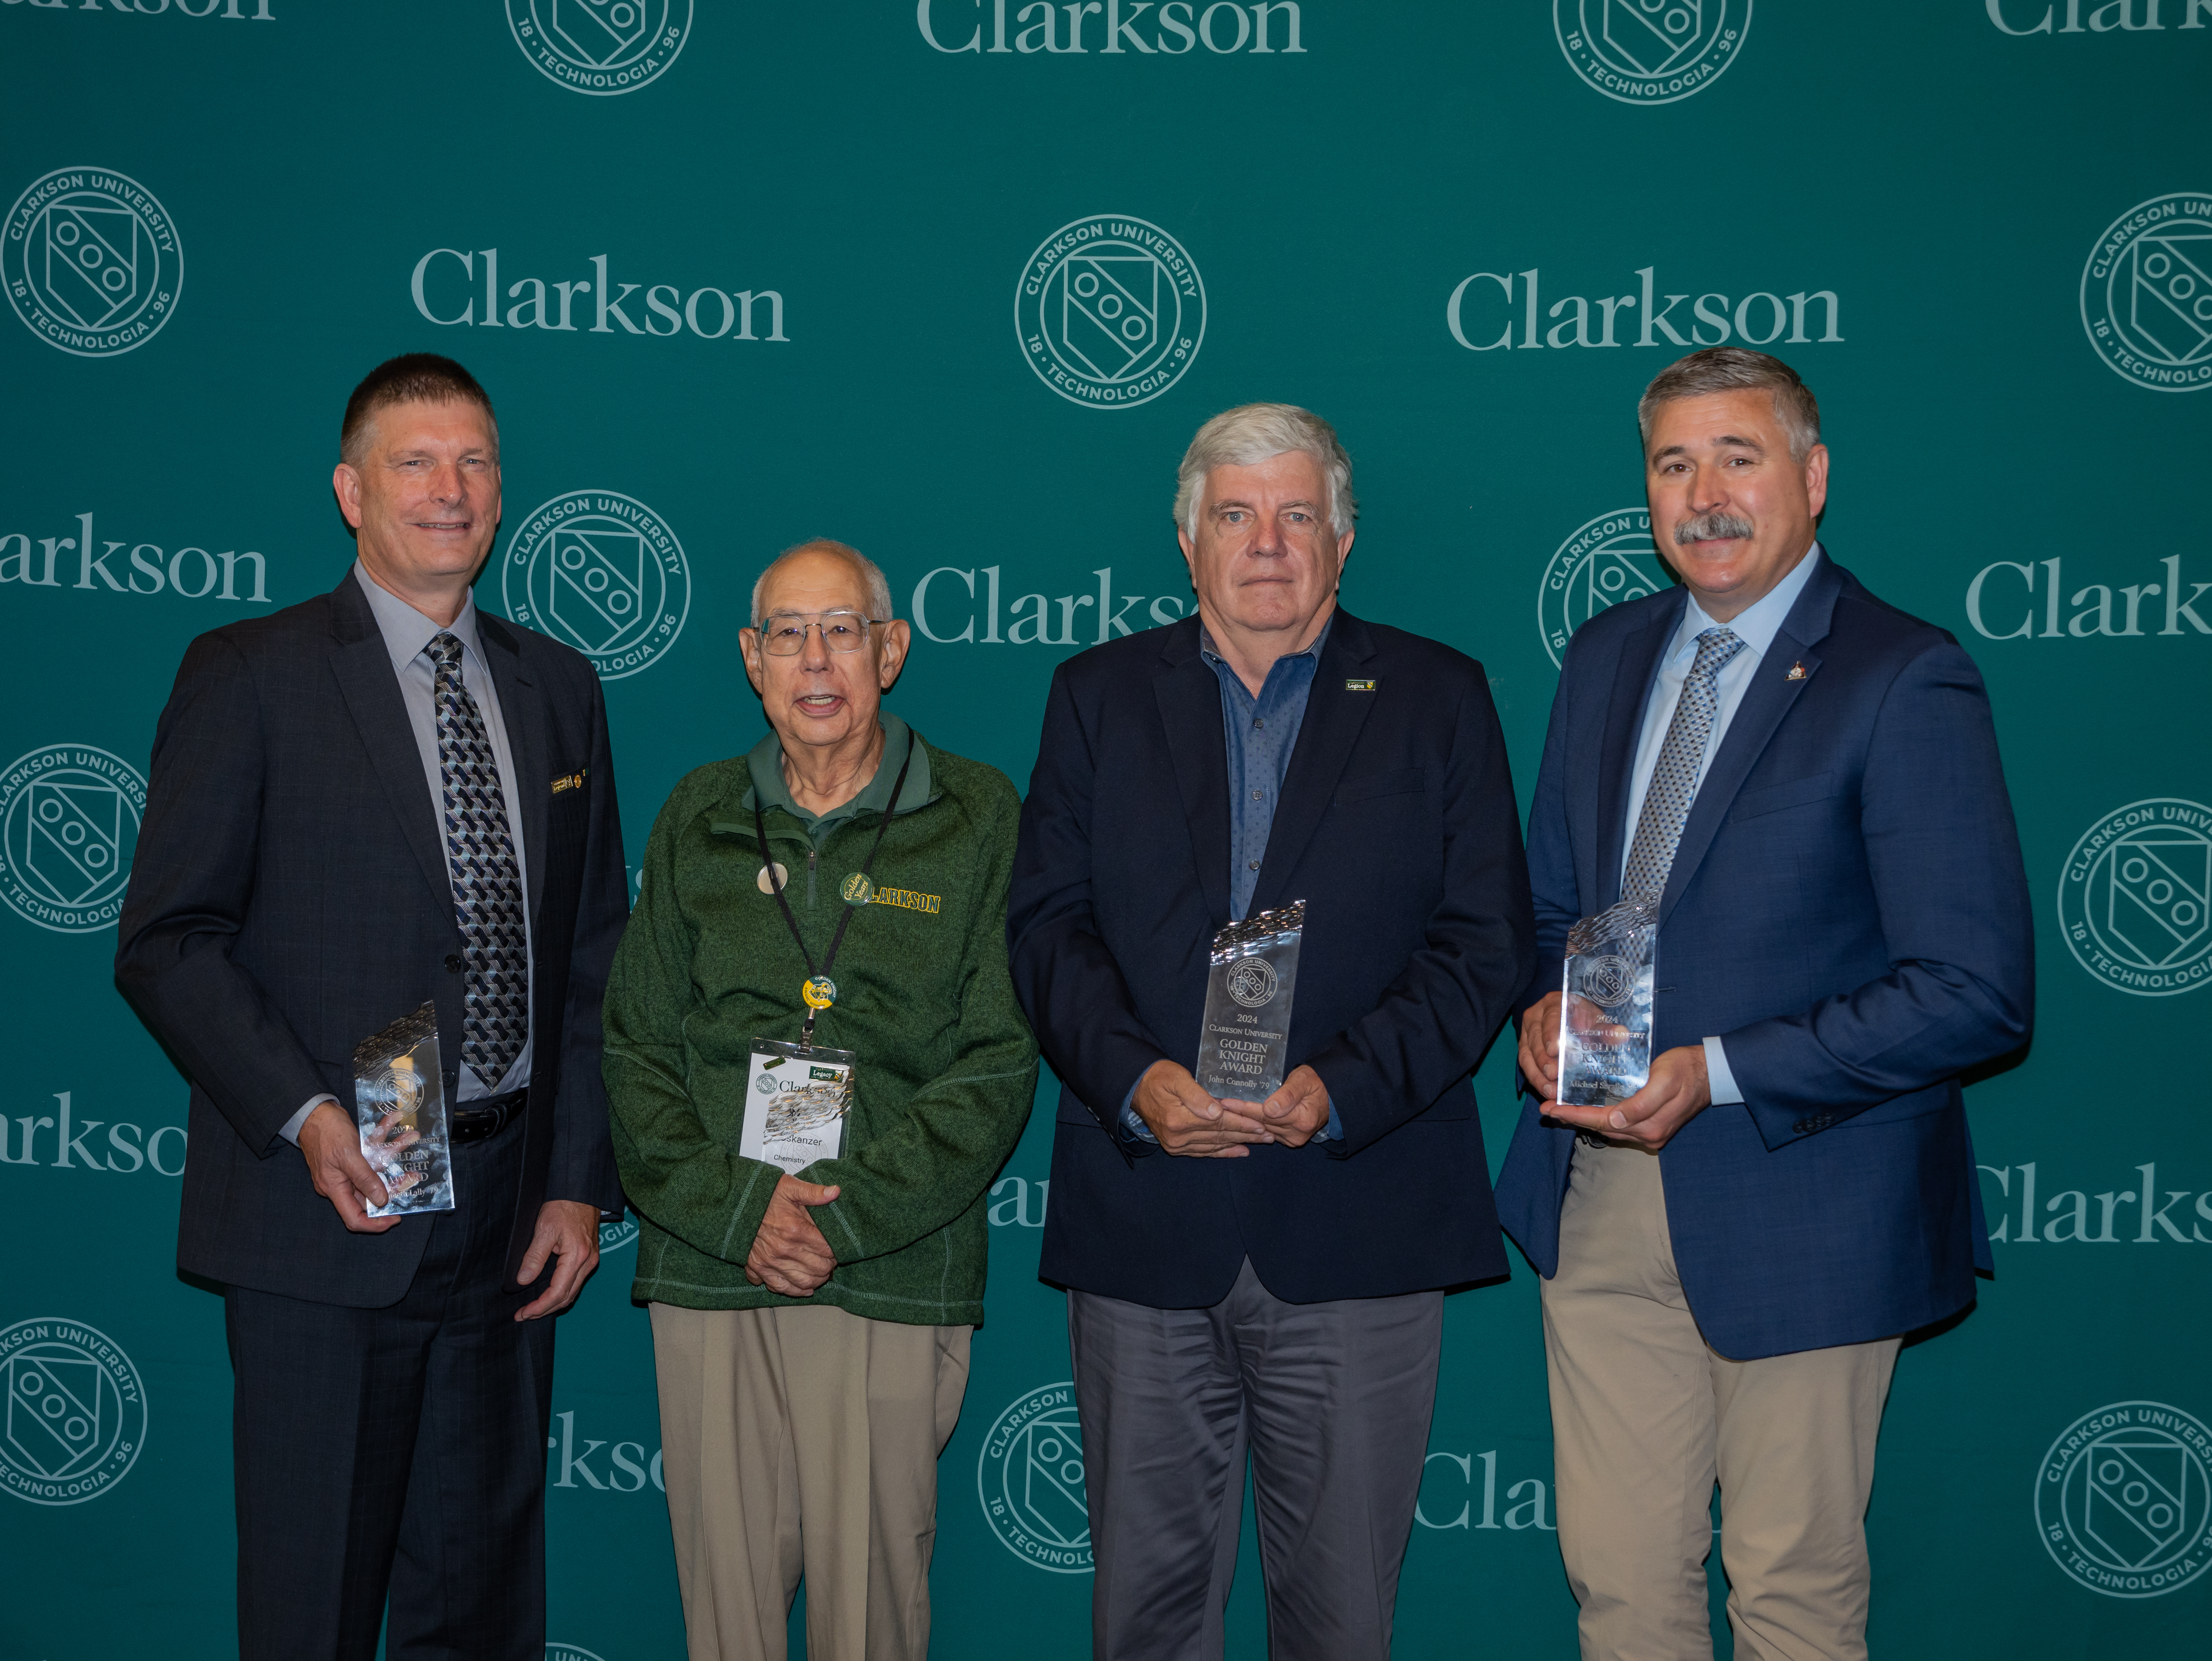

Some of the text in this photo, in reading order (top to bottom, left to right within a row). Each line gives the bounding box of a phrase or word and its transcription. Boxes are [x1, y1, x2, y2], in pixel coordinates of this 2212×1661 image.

[917, 0, 1307, 54] Clarkson
[519, 18, 679, 87] 18 TECHNOLOGIA 96
[1567, 29, 1737, 96] 18 TECHNOLOGIA 96
[11, 175, 175, 252] CLARKSON UNIVERSITY
[1026, 223, 1196, 296] CLARKSON UNIVERSITY
[2093, 203, 2176, 278] CLARKSON
[12, 279, 170, 348] 18 TECHNOLOGIA 96
[411, 248, 790, 342] Clarkson
[1447, 266, 1844, 351] Clarkson
[2094, 318, 2110, 337] 18
[1028, 334, 1192, 401] 18 TECHNOLOGIA 96
[514, 498, 681, 574] CLARKSON UNIVERSITY
[1551, 518, 1630, 590] CLARKSON
[515, 603, 530, 622] 18
[659, 614, 676, 636] 96
[912, 565, 1199, 645] Clarks
[1551, 629, 1566, 648] 18
[76, 752, 147, 816] UNIVERSI
[2071, 808, 2154, 881] CLARKSON
[844, 873, 862, 901] Golden
[854, 881, 868, 898] Years
[867, 887, 941, 913] LARKSON
[2071, 921, 2086, 940] 18
[1230, 959, 1275, 981] CLARKSON UNIVERSITY
[1234, 993, 1266, 1006] TECHNOLOGIA
[1236, 1014, 1258, 1024] 2024
[1596, 1015, 1619, 1024] 2024
[1209, 1024, 1283, 1040] CLARKSON UNIVERSITY
[1220, 1039, 1268, 1053] GOLDEN
[813, 1070, 833, 1079] Legacy
[1219, 1050, 1266, 1064] KNIGHT
[1219, 1061, 1262, 1075] AWARD
[1584, 1065, 1627, 1076] AWARD
[1208, 1075, 1224, 1084] John
[1226, 1077, 1257, 1090] Connolly
[774, 1155, 806, 1165] Chemistry
[56, 1326, 138, 1402] UNIVERSITY
[990, 1391, 1068, 1458] CLARKSON
[2047, 1410, 2130, 1482] CLARKSON
[0, 1441, 132, 1497] ECHNOLOGIA 96
[990, 1497, 1005, 1516] 18
[2048, 1522, 2063, 1541] 18
[2068, 1551, 2197, 1589] TECHNOLOGIA
